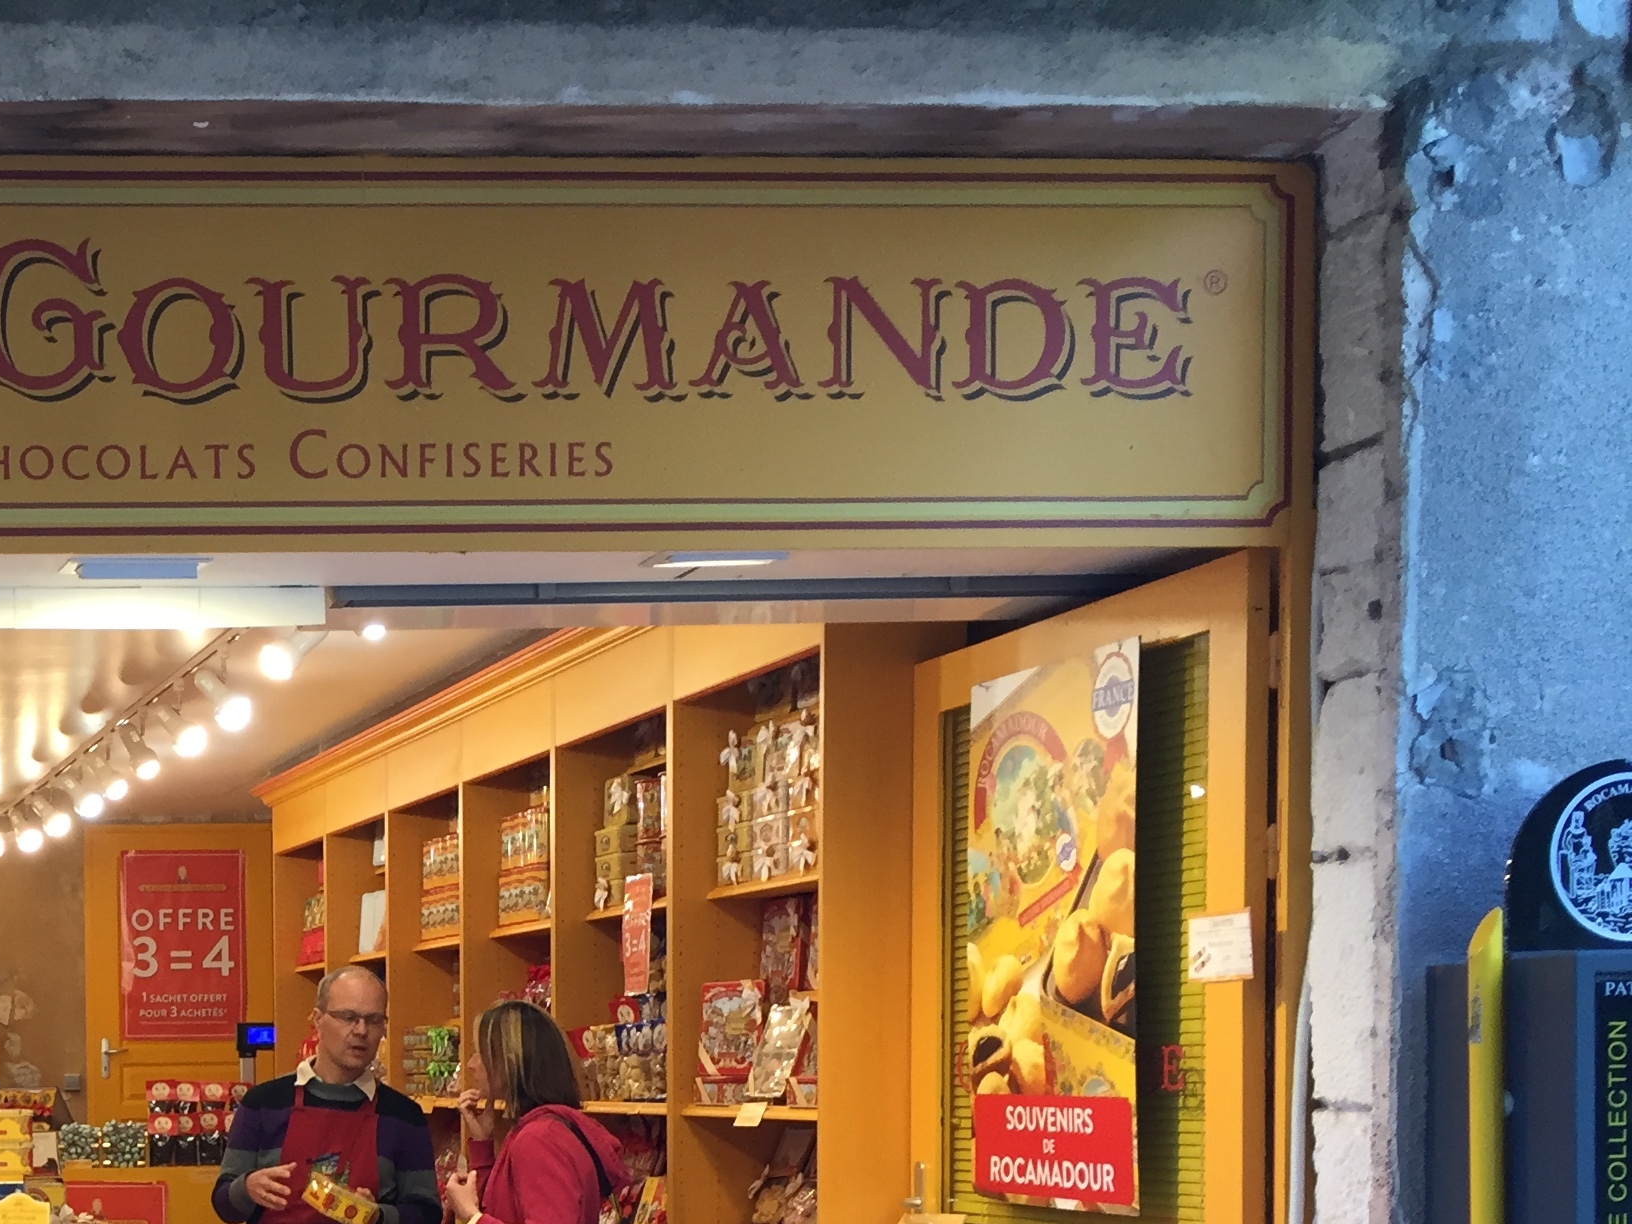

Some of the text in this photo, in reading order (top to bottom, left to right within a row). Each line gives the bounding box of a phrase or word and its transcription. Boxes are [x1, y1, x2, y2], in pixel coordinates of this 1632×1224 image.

[288, 430, 615, 483] CONFISERIES
[1092, 684, 1135, 709] FRANCE
[1583, 783, 1632, 813] ROCAM
[131, 908, 235, 931] OFFRE
[141, 991, 228, 1003] 1 SACHET OFFERT
[139, 1008, 167, 1018] POUR
[169, 1005, 178, 1018] 3
[1005, 1105, 1094, 1135] SOUVENIRS
[1607, 1020, 1628, 1202] COLLECTION
[1042, 1138, 1056, 1154] DE
[989, 1155, 1115, 1193] ROCAMADOUR
